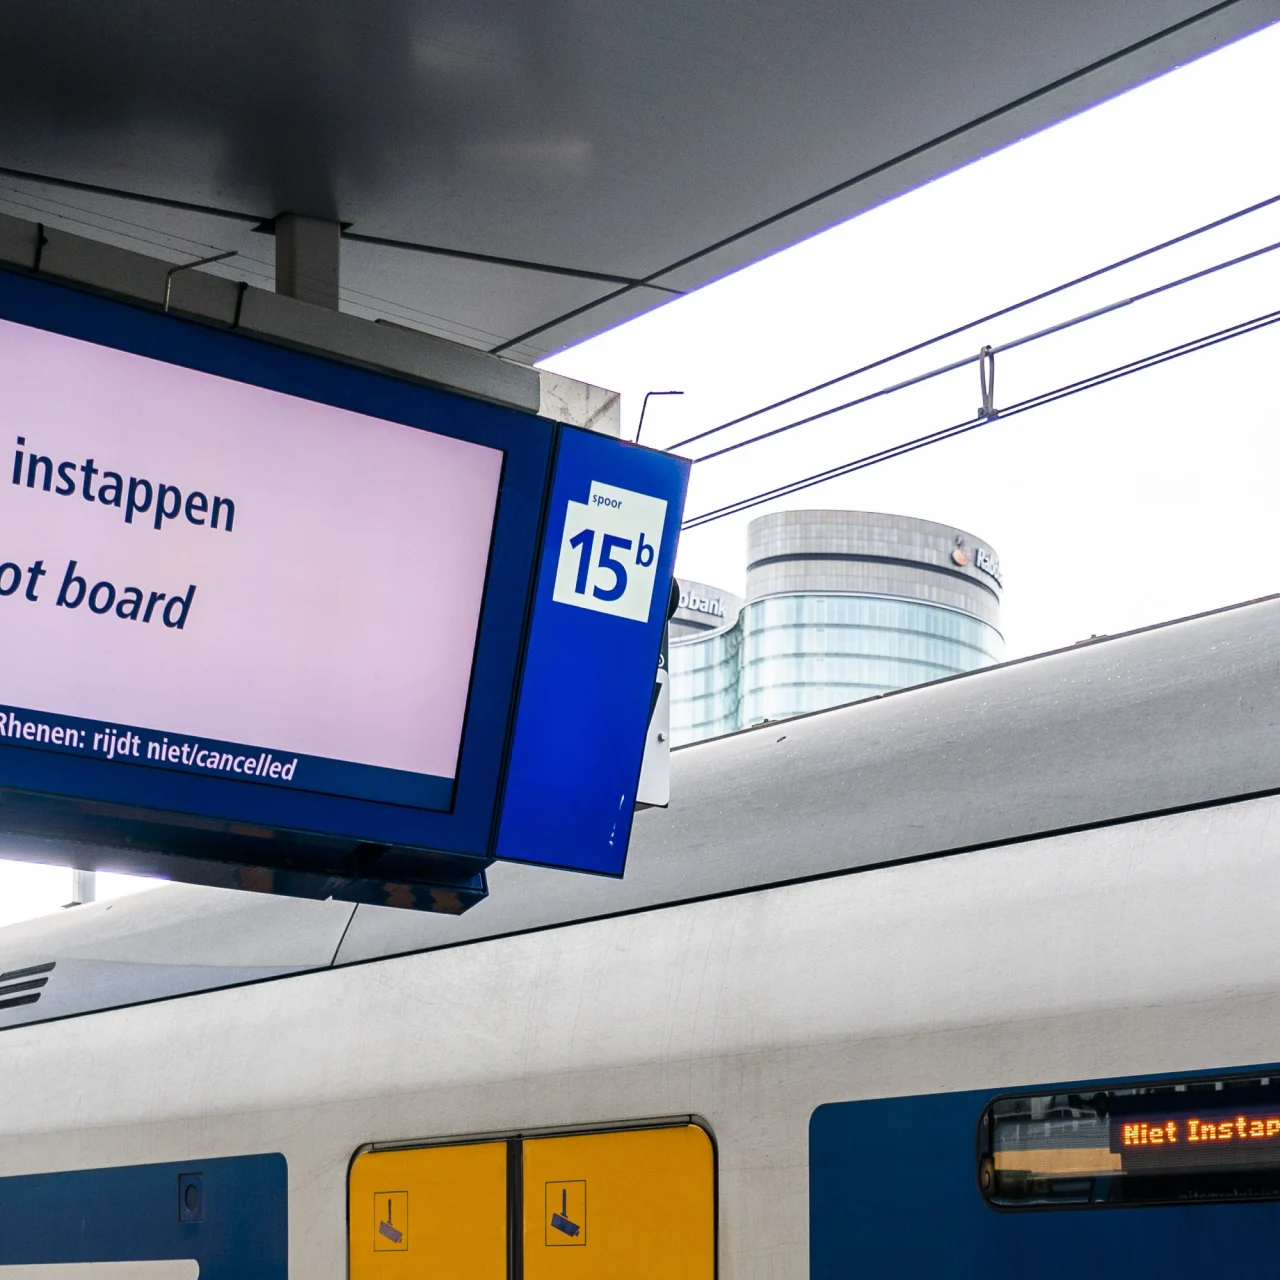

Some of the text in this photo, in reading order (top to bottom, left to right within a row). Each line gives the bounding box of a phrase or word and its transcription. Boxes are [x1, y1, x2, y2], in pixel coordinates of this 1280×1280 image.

[12, 436, 236, 532] instappen
[593, 494, 623, 509] spoor
[55, 560, 197, 630] board
[93, 728, 141, 759] rijdt
[147, 738, 298, 781] niet/cancelled
[1123, 1121, 1177, 1145] Niet
